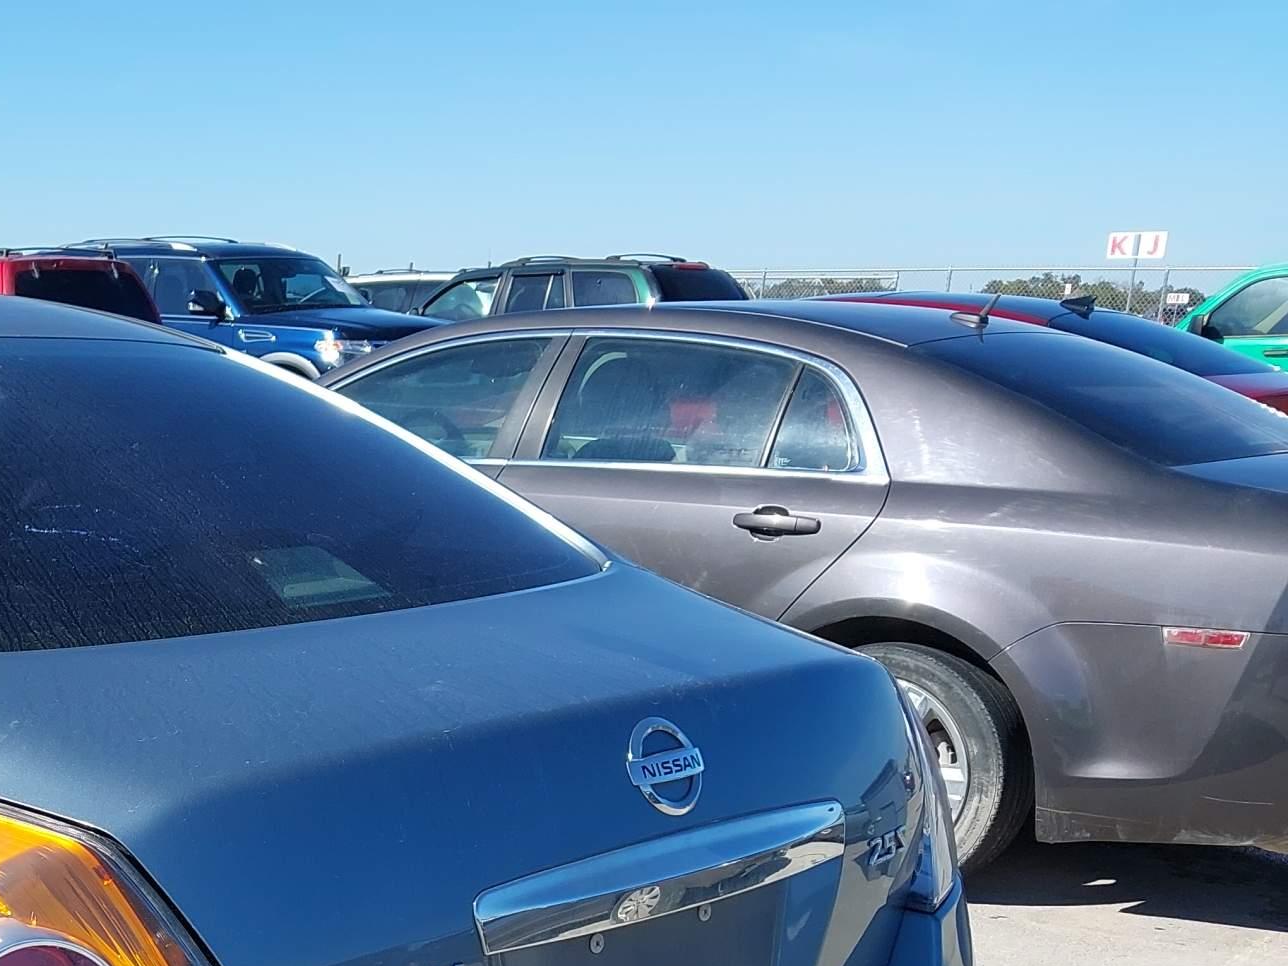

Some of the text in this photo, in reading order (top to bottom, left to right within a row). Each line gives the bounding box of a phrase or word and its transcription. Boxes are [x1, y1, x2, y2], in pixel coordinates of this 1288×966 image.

[1110, 233, 1161, 256] K J
[641, 752, 702, 779] NISSAN
